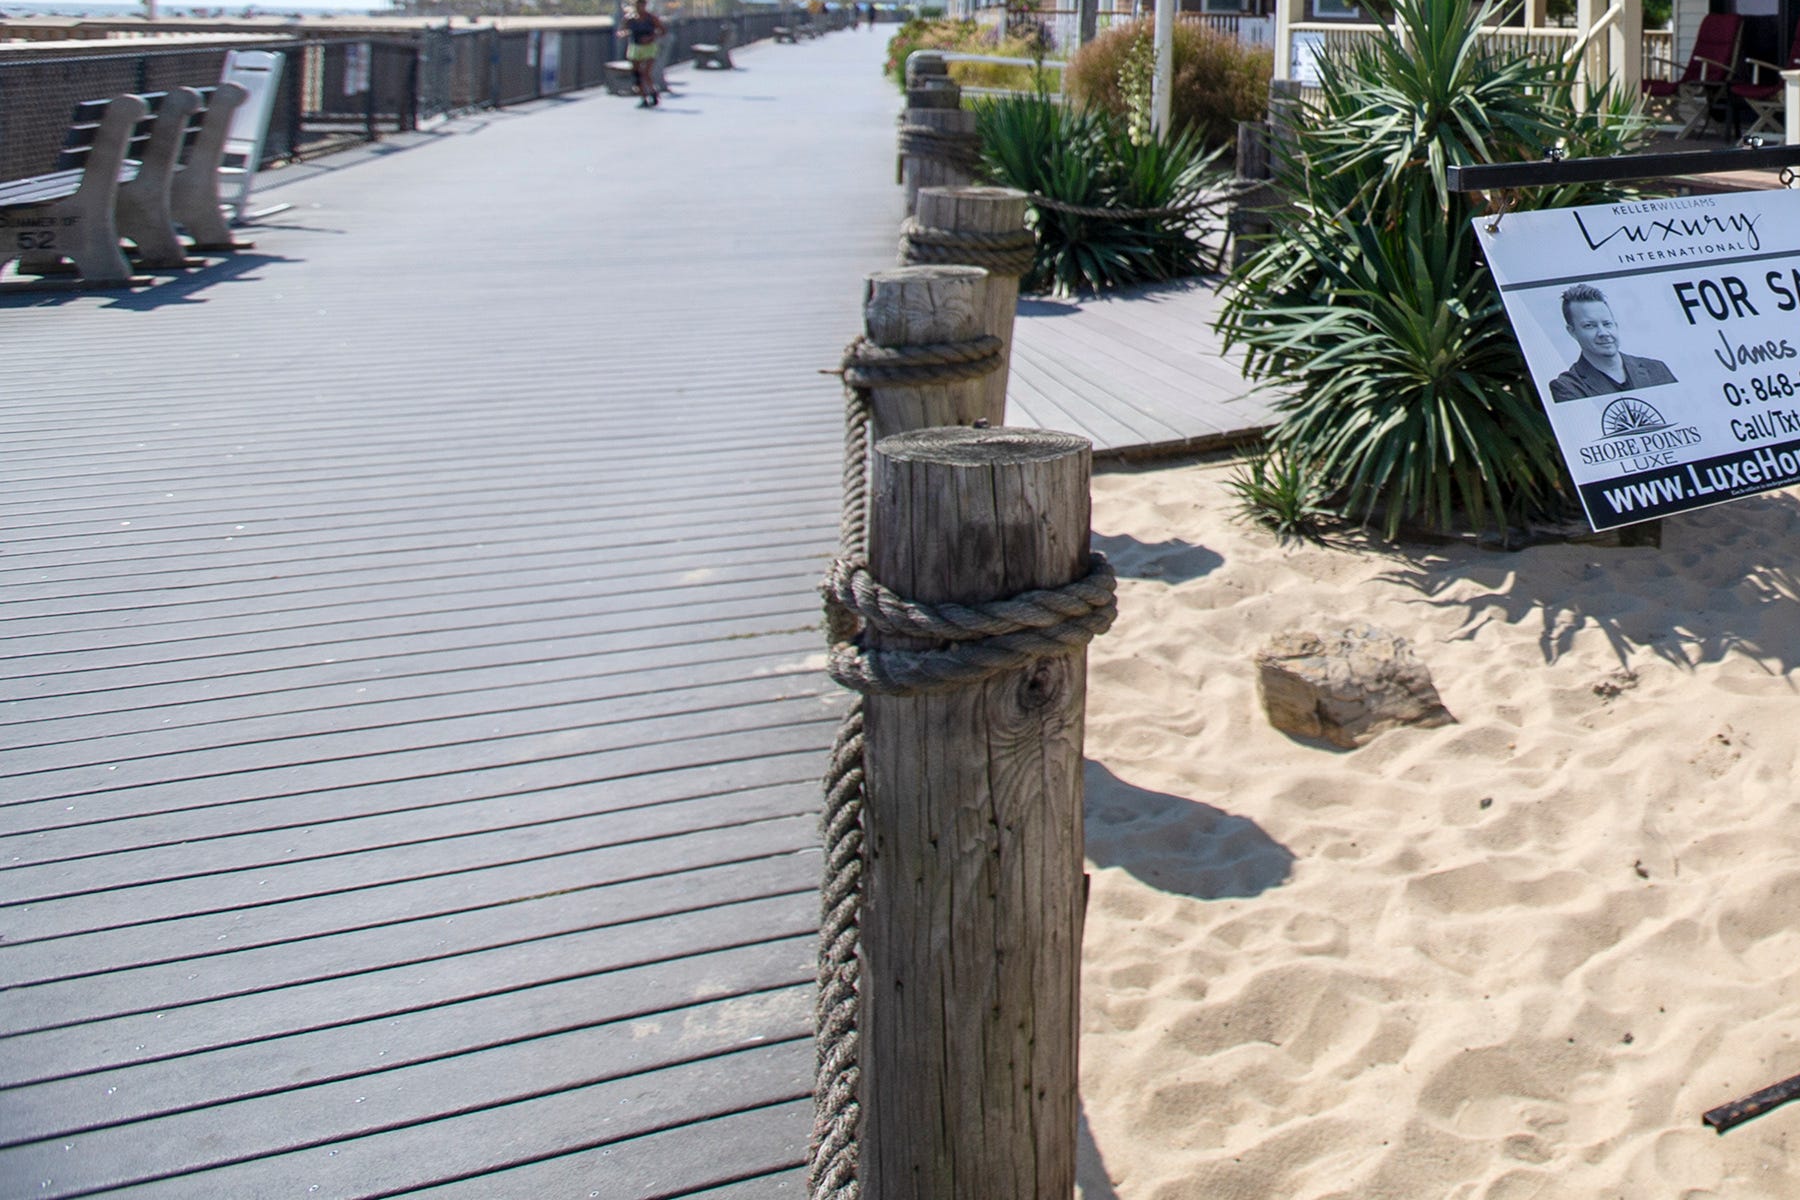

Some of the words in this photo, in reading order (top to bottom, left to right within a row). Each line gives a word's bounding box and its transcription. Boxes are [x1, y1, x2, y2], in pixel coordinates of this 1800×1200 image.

[17, 230, 56, 250] 52
[1573, 210, 1762, 251] Luxury
[1618, 241, 1745, 263] INTERNATIONAL
[1673, 276, 1760, 325] FOR
[1714, 329, 1797, 372] James
[1580, 438, 1640, 465] SHORE
[1640, 426, 1702, 452] POINTS
[1620, 451, 1678, 473] LUXE
